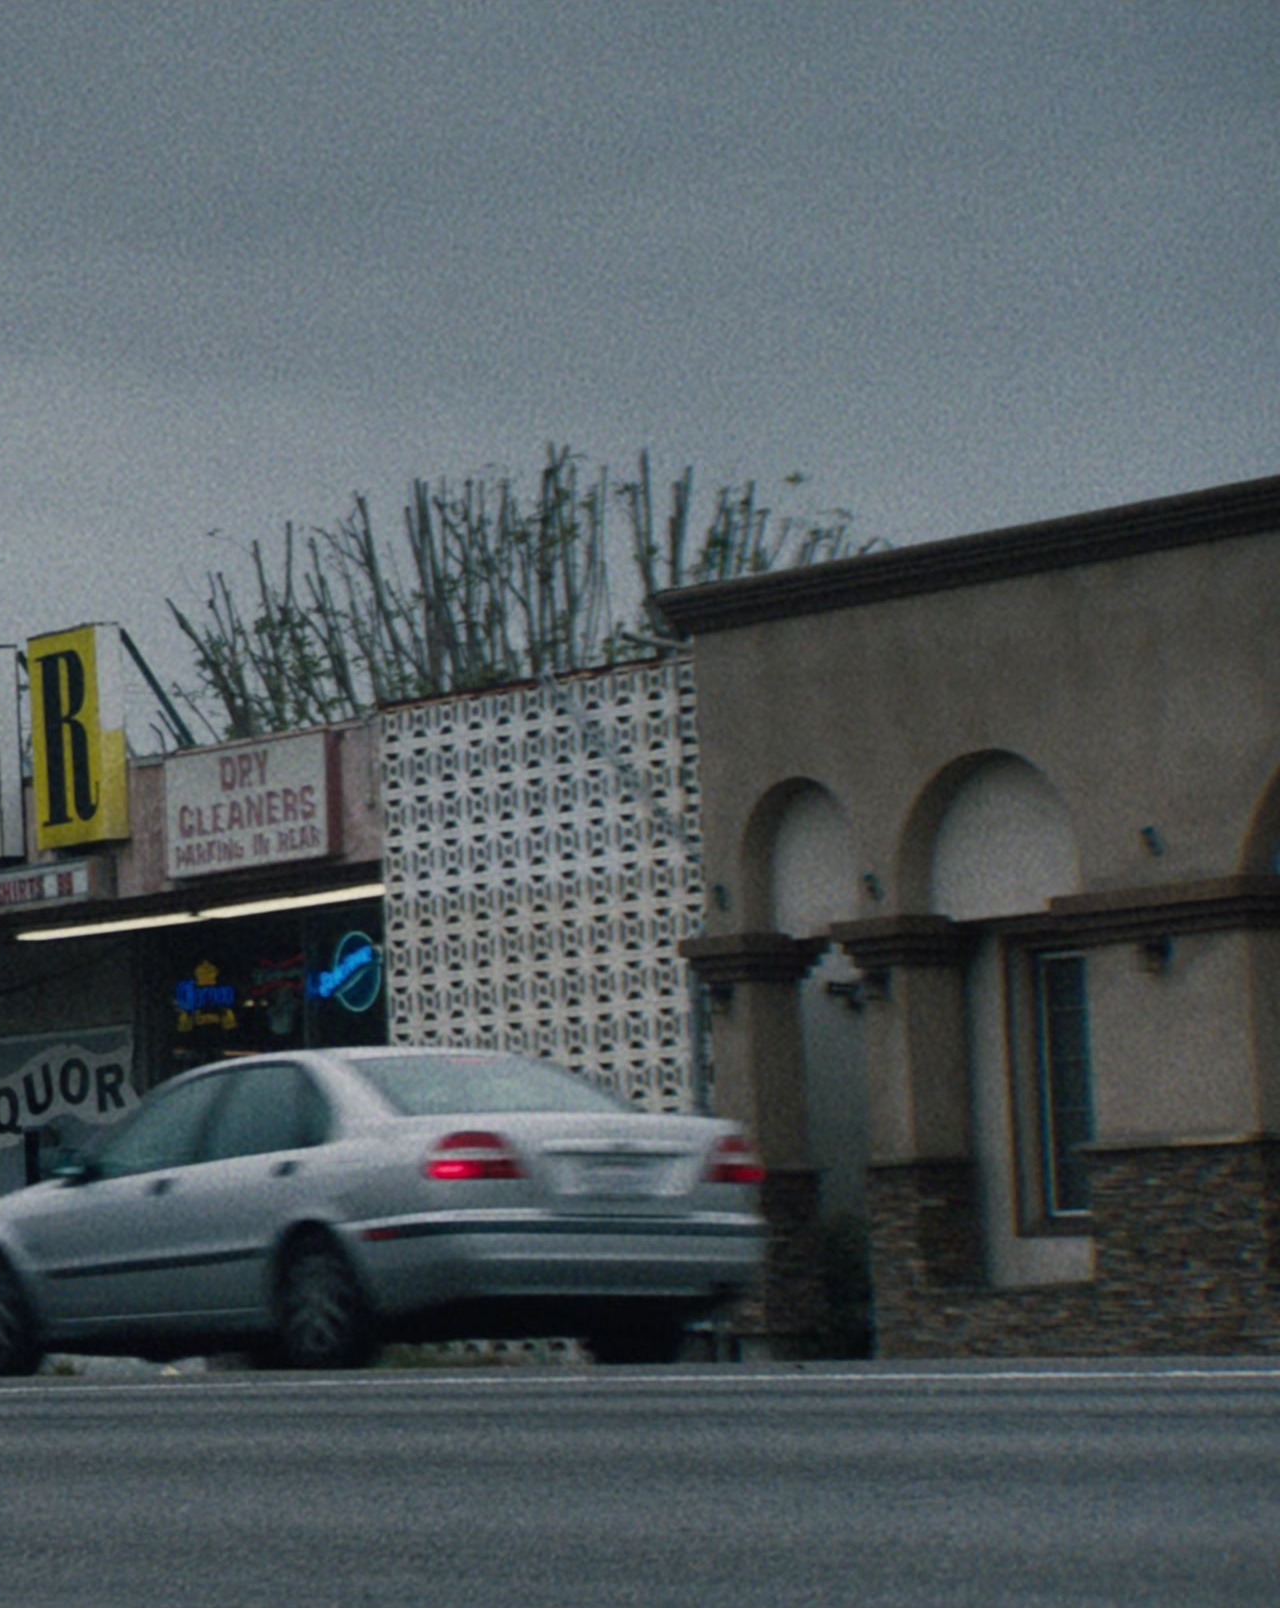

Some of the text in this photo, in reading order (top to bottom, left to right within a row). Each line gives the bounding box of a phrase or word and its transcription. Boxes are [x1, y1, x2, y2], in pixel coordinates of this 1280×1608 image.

[219, 750, 269, 792] DRY
[178, 785, 316, 838] CLEANERS
[276, 824, 321, 851] REAR
